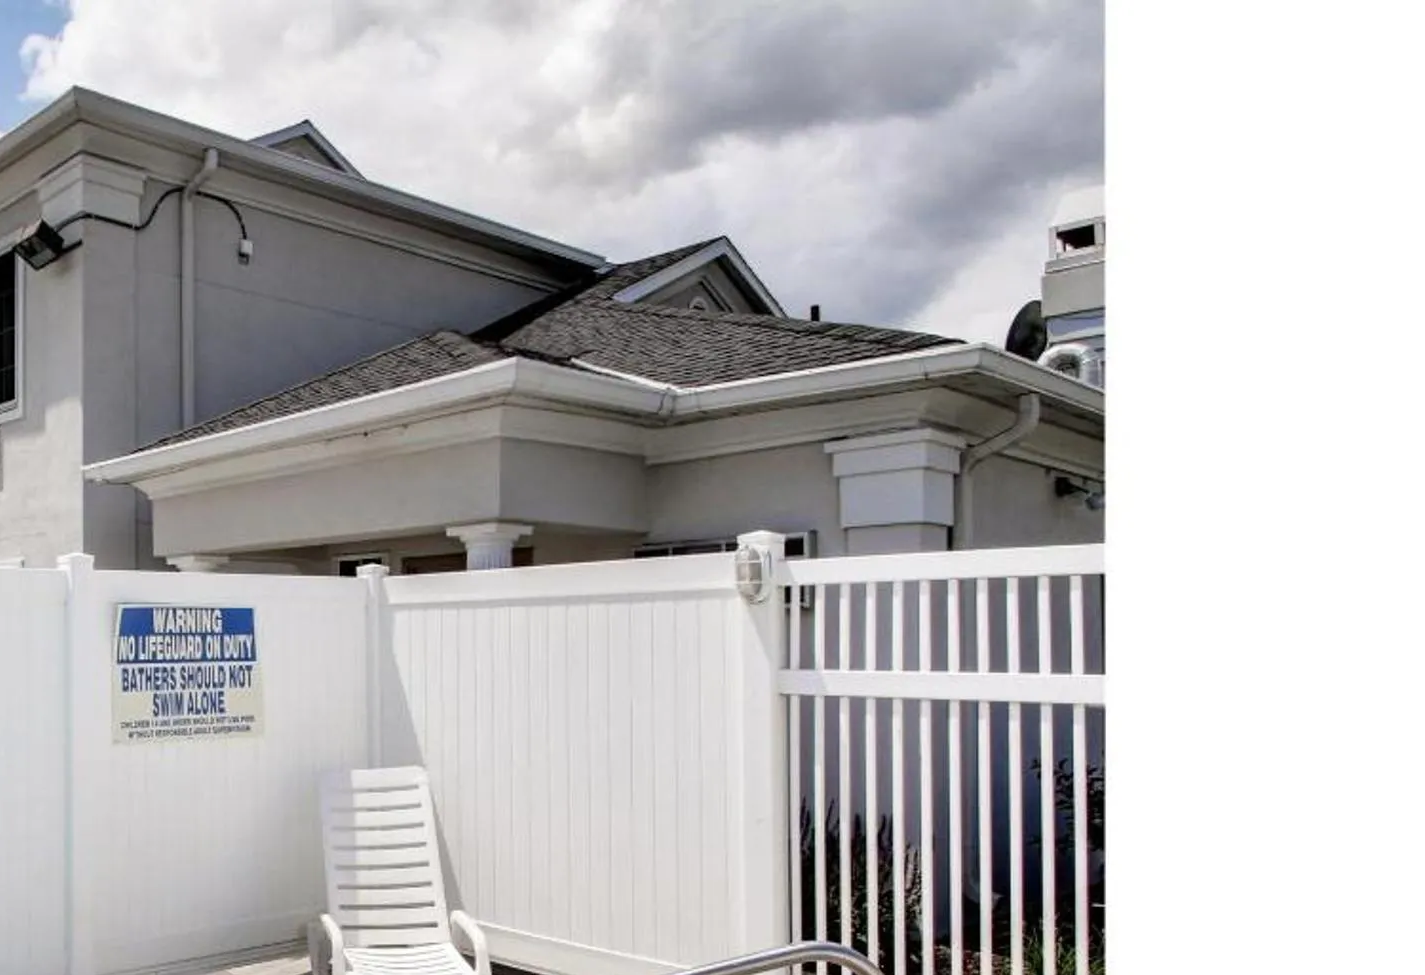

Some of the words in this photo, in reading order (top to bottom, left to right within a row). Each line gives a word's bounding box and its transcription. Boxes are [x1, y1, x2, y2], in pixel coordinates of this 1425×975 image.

[153, 608, 223, 633] WARNING
[119, 636, 135, 661] NO
[138, 635, 202, 660] LIFEGUARD
[205, 635, 221, 659] ON
[224, 634, 253, 659] DUTY
[122, 667, 176, 692] BATHERS
[180, 665, 226, 690] SHOULD
[229, 665, 253, 688] NOT
[152, 692, 184, 716] SWIM
[187, 690, 226, 715] ALONE
